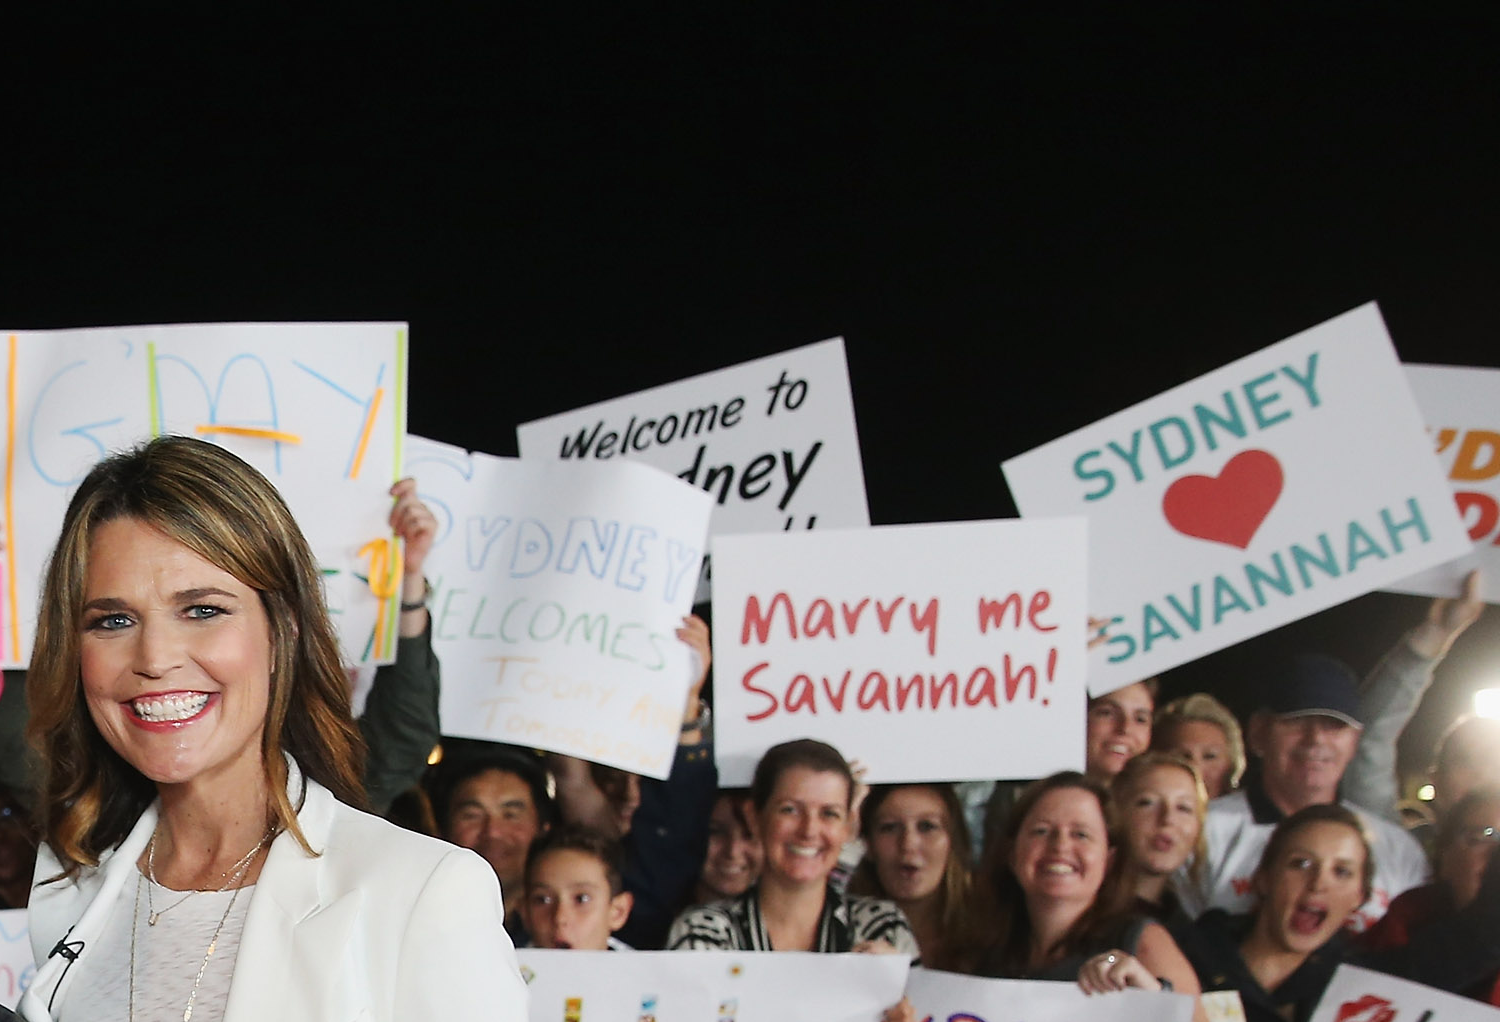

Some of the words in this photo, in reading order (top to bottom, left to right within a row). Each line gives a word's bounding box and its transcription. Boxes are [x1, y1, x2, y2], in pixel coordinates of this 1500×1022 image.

[559, 395, 746, 460] Welcome
[765, 368, 809, 417] to
[1073, 351, 1321, 502] SYDNEY
[676, 440, 824, 512] dney
[1104, 497, 1432, 664] SAVANNAH
[740, 592, 939, 657] Marry
[978, 590, 1059, 635] me
[742, 647, 1059, 721] Savannah!
